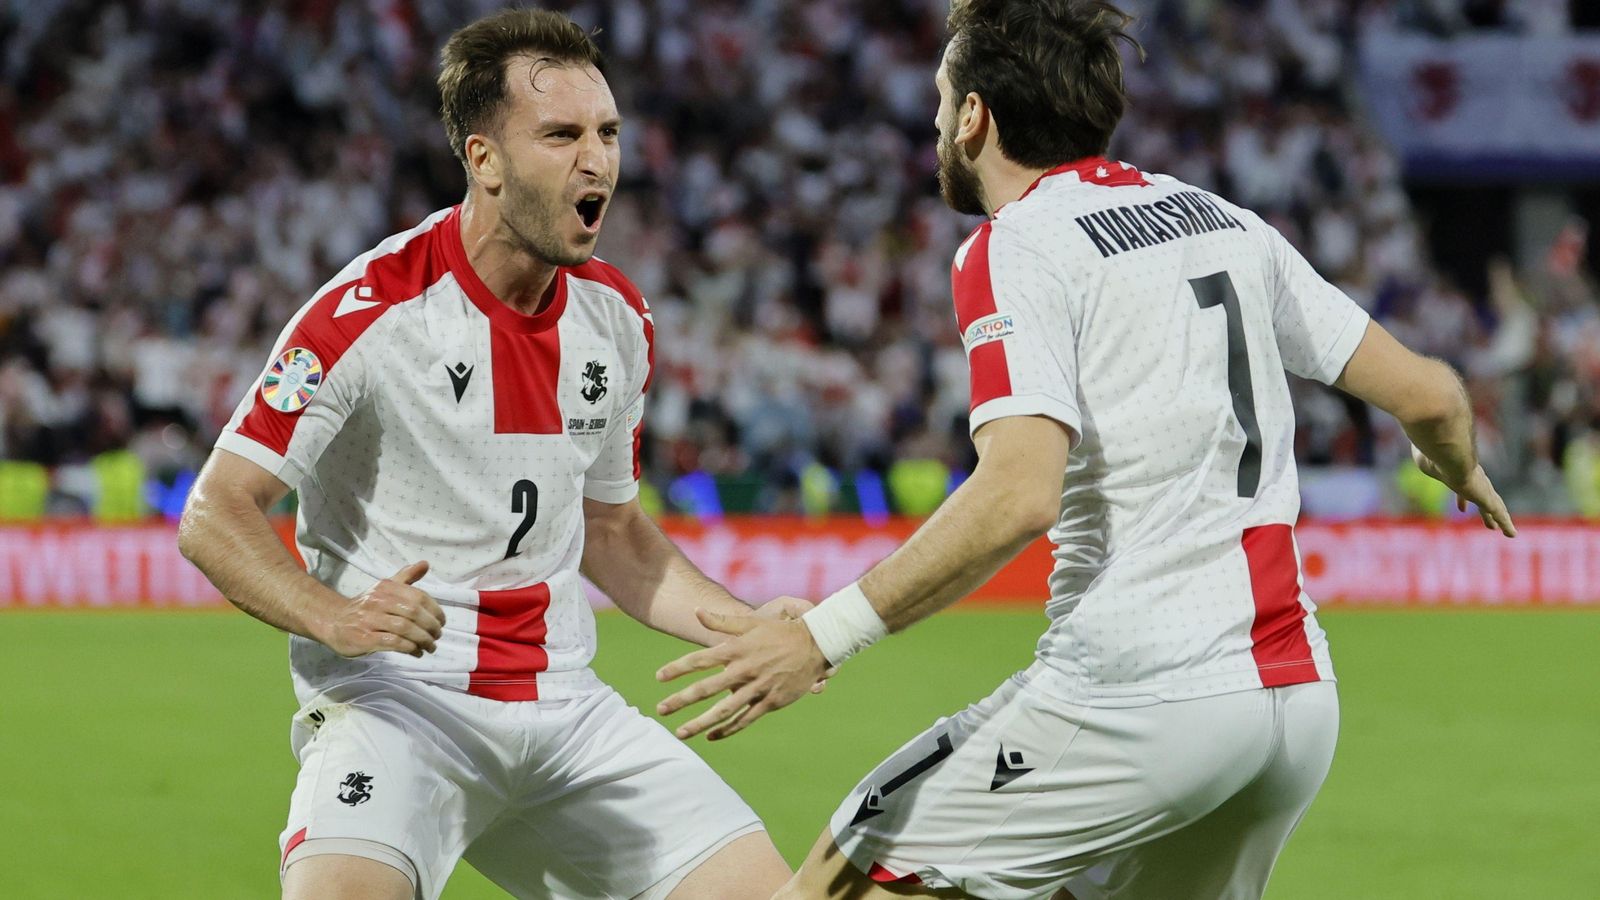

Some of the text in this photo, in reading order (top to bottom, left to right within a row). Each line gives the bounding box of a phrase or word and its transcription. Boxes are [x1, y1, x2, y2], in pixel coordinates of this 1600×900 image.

[1188, 270, 1262, 498] 7
[568, 418, 586, 430] SPAIN
[505, 479, 538, 559] 2
[880, 733, 953, 797] 7
